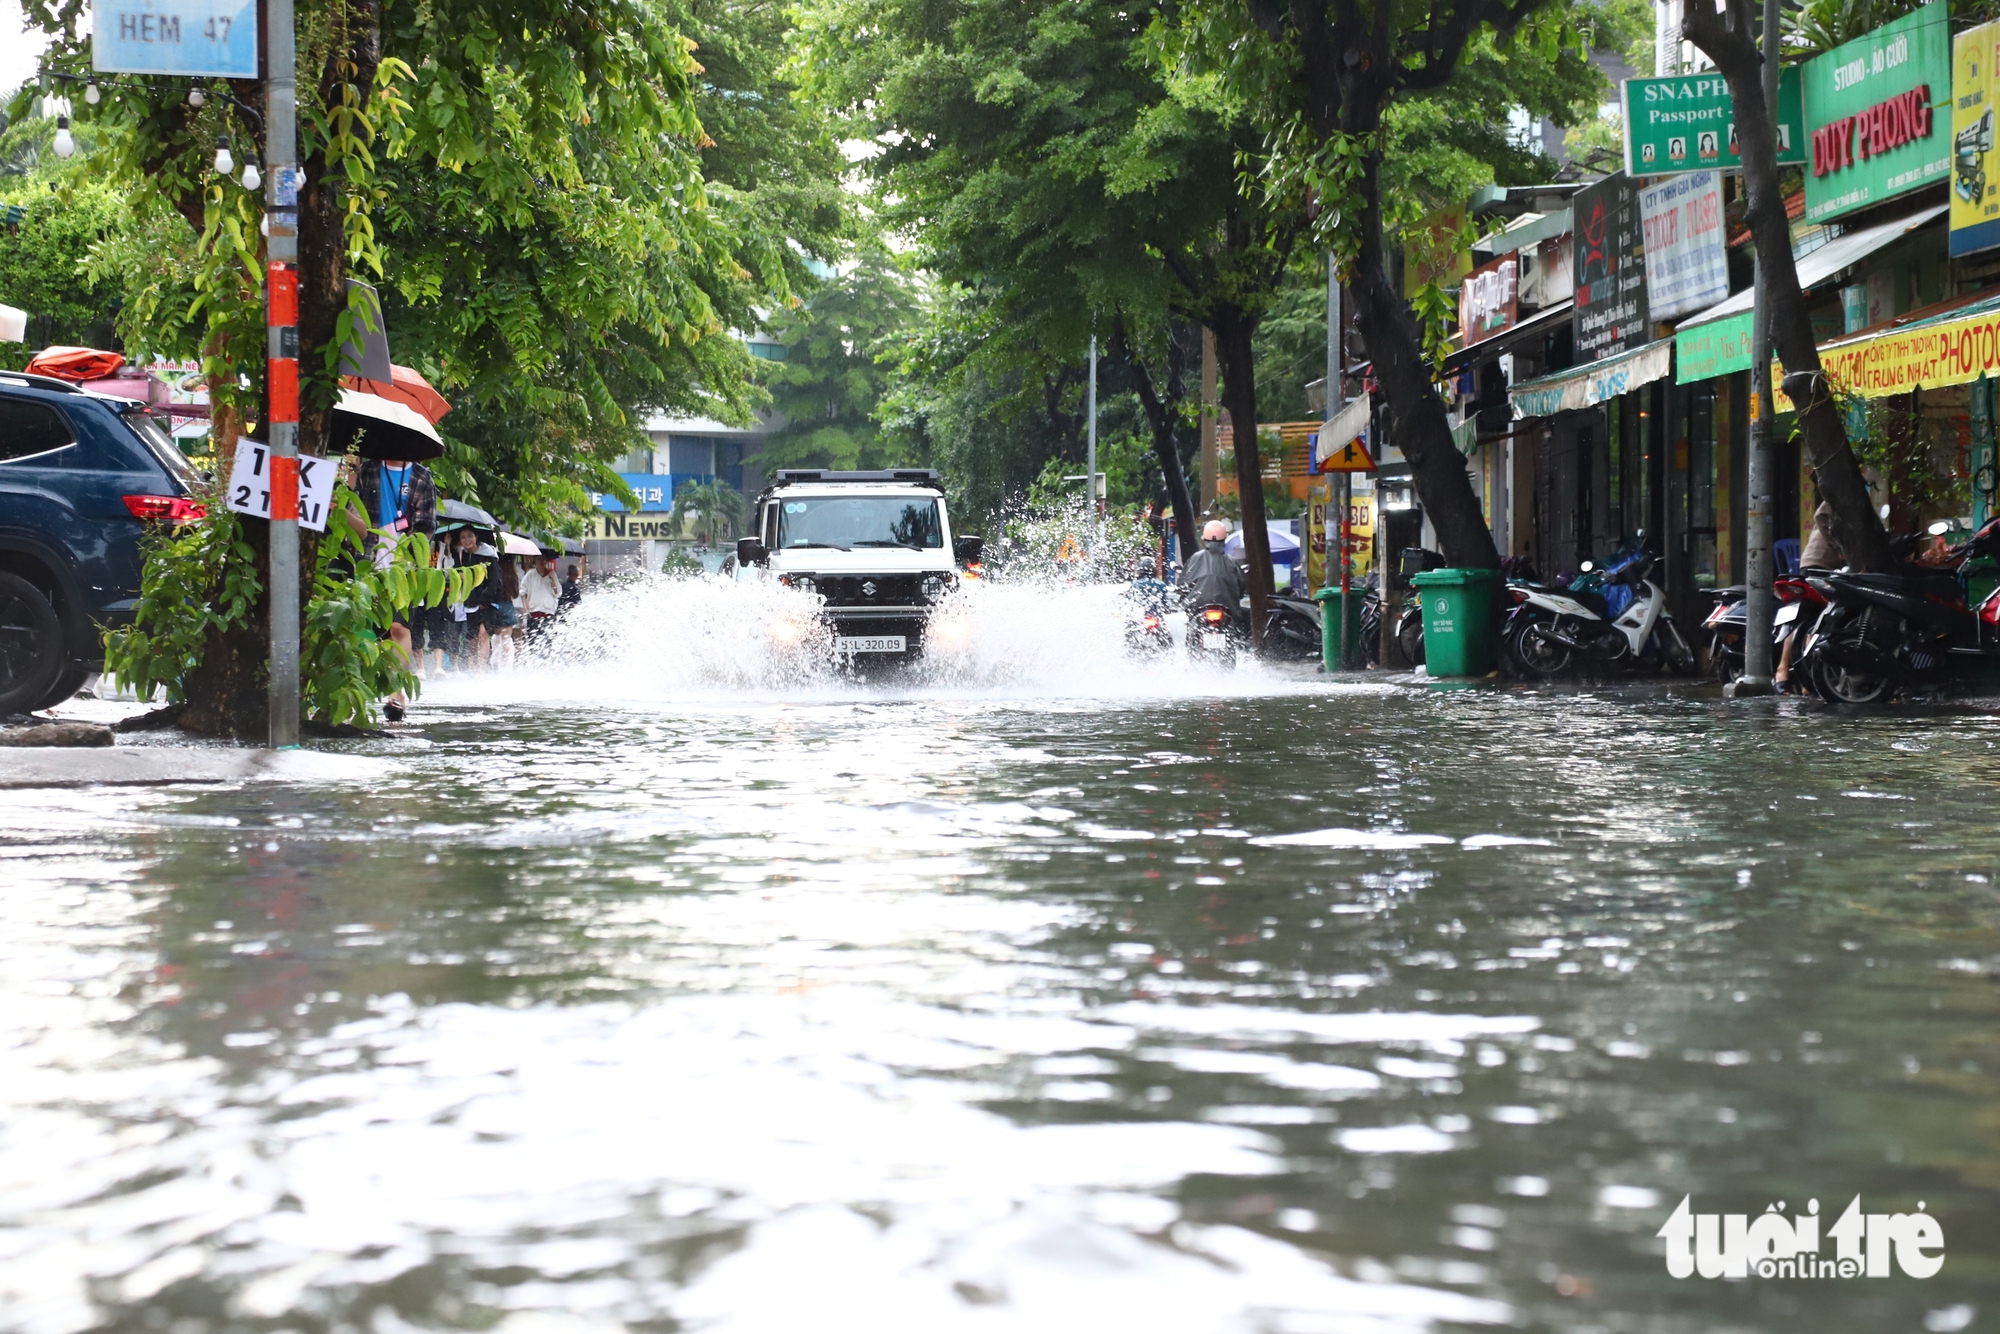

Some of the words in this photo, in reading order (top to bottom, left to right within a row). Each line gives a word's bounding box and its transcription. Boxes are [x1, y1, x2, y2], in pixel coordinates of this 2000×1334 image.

[203, 16, 231, 44] 47
[1834, 57, 1865, 92] STUDIO
[1872, 45, 1884, 76] ÁO
[1649, 106, 1723, 124] Passport
[1811, 116, 1856, 177] DUY
[1855, 84, 1933, 160] PHONG
[1645, 191, 1658, 209] CTY
[1678, 178, 1689, 196] GIA
[1868, 366, 1904, 389] TRUNG
[234, 485, 251, 508] 2
